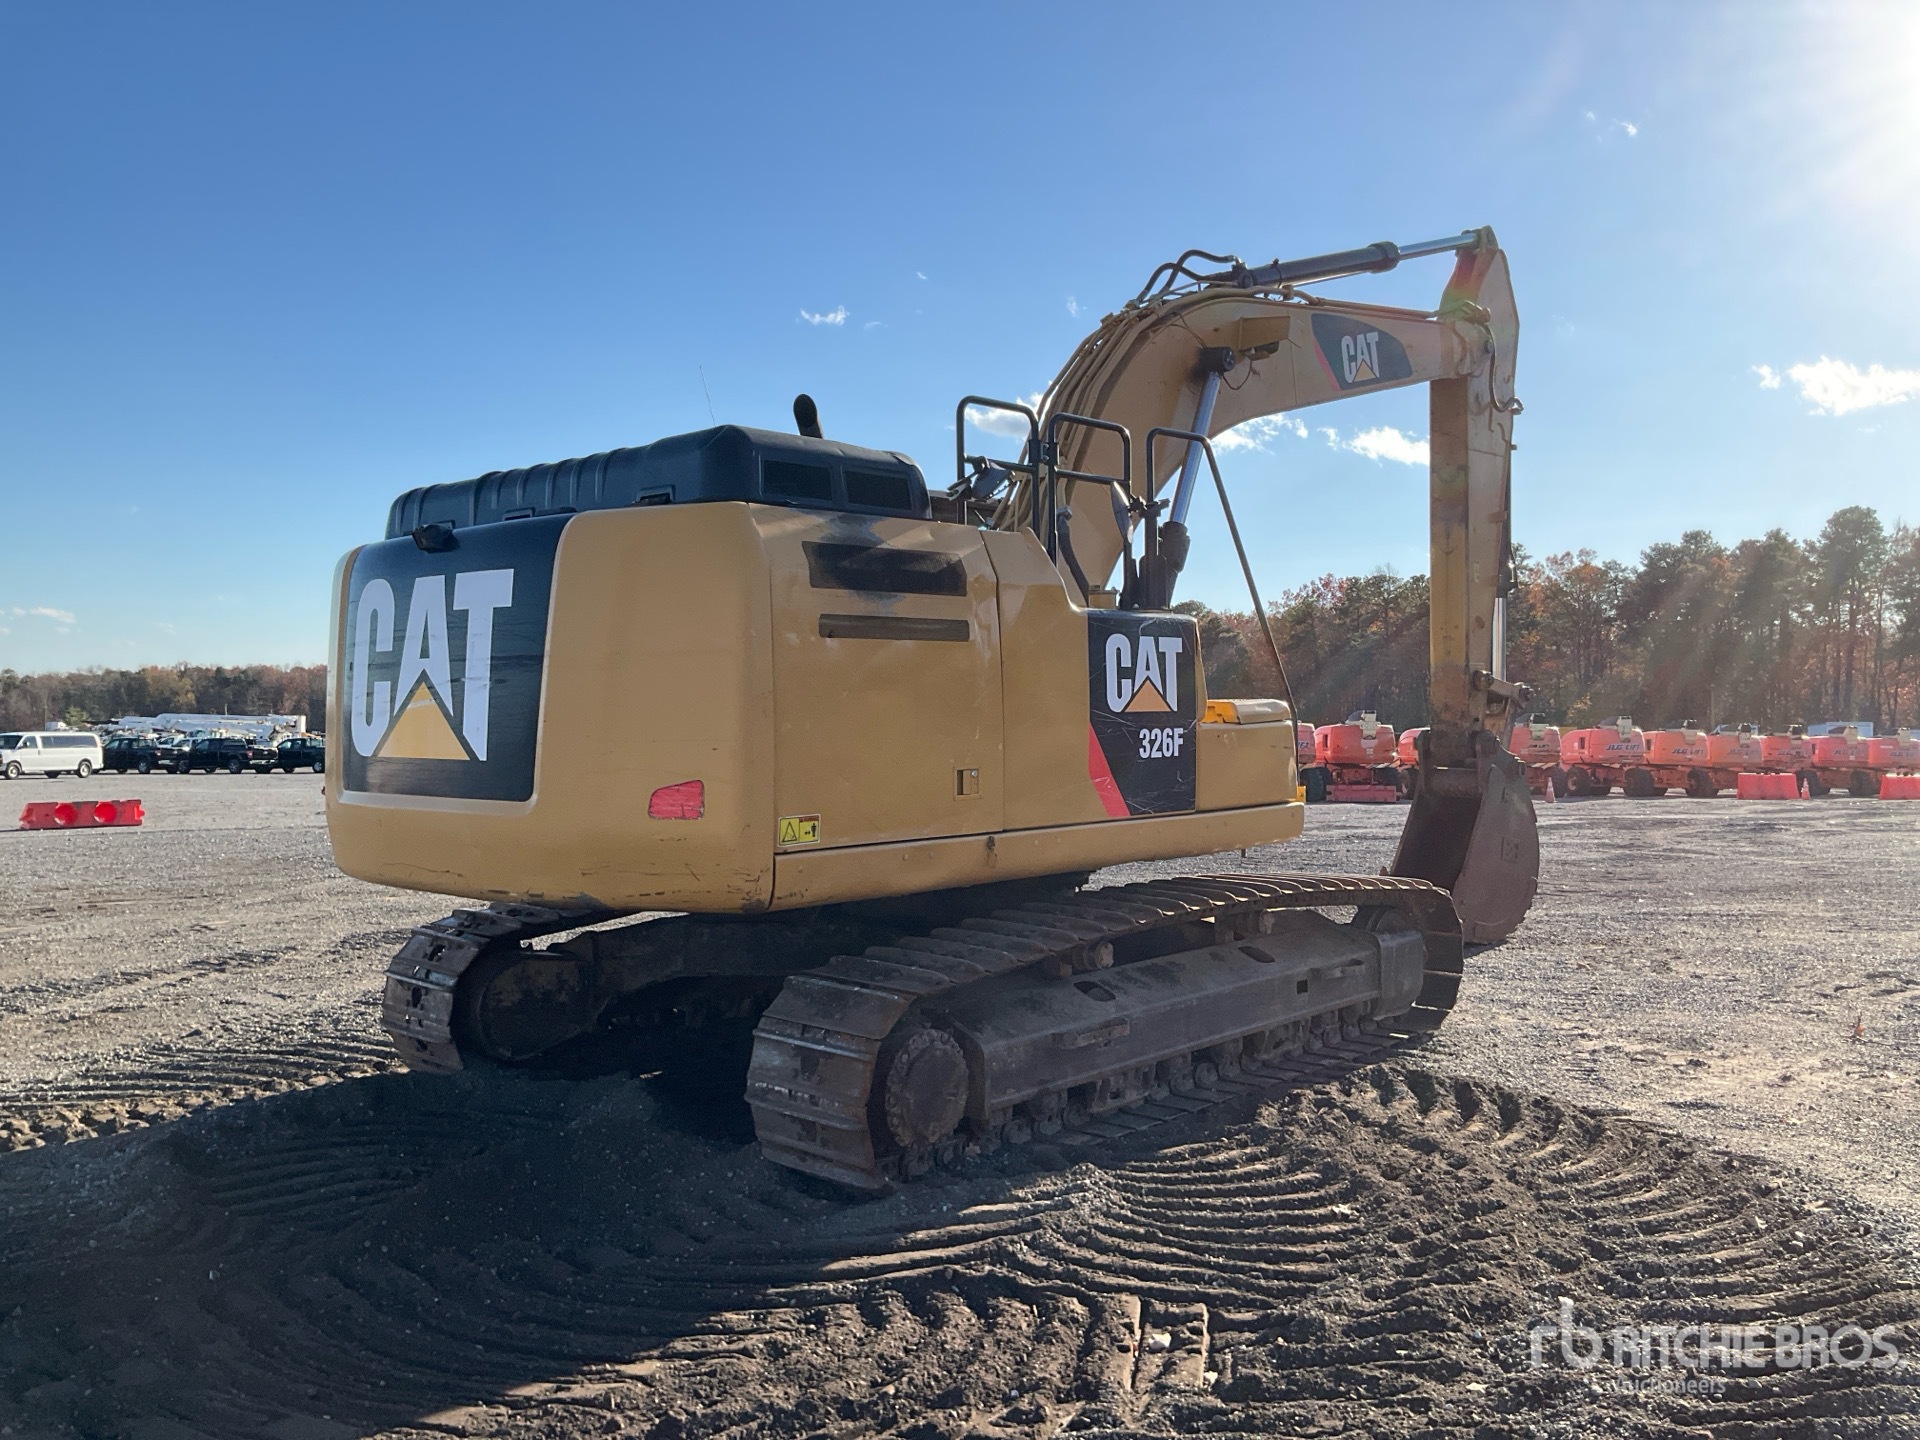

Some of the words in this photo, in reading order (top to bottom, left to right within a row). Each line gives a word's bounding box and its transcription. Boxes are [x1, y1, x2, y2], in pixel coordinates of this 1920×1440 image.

[1341, 331, 1380, 384] CAT
[351, 568, 514, 762] CAT
[1105, 633, 1182, 713] CAT
[1139, 728, 1184, 758] 326F
